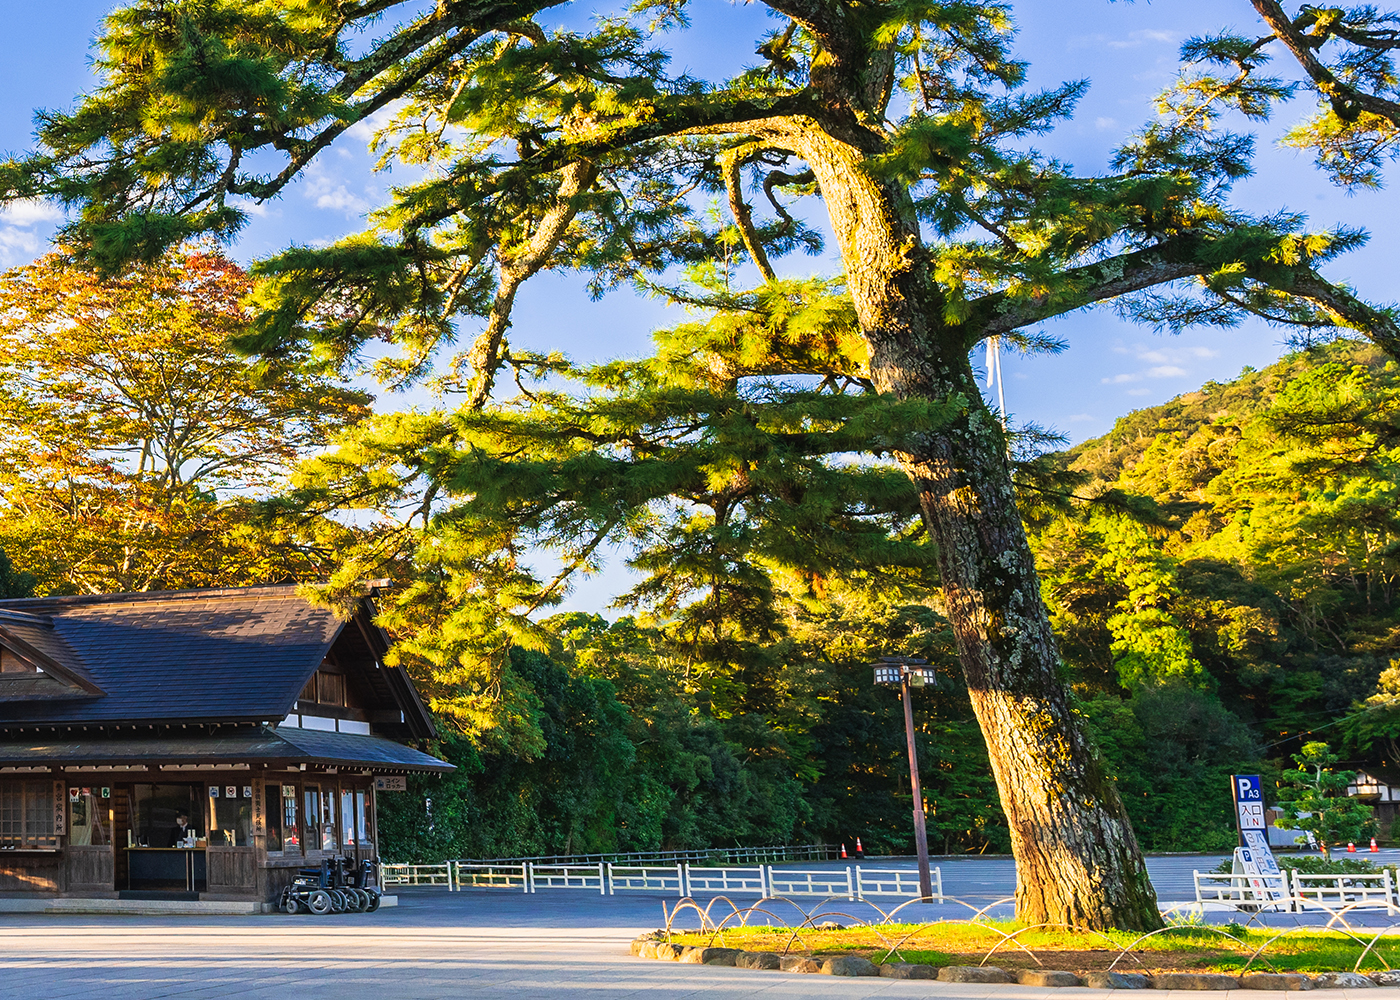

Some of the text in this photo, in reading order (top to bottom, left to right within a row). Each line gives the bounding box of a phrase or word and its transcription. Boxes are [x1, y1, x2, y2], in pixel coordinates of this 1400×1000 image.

[1238, 778, 1260, 799] P A3
[55, 783, 63, 832] 参宮案内所
[1241, 805, 1261, 816] 入口
